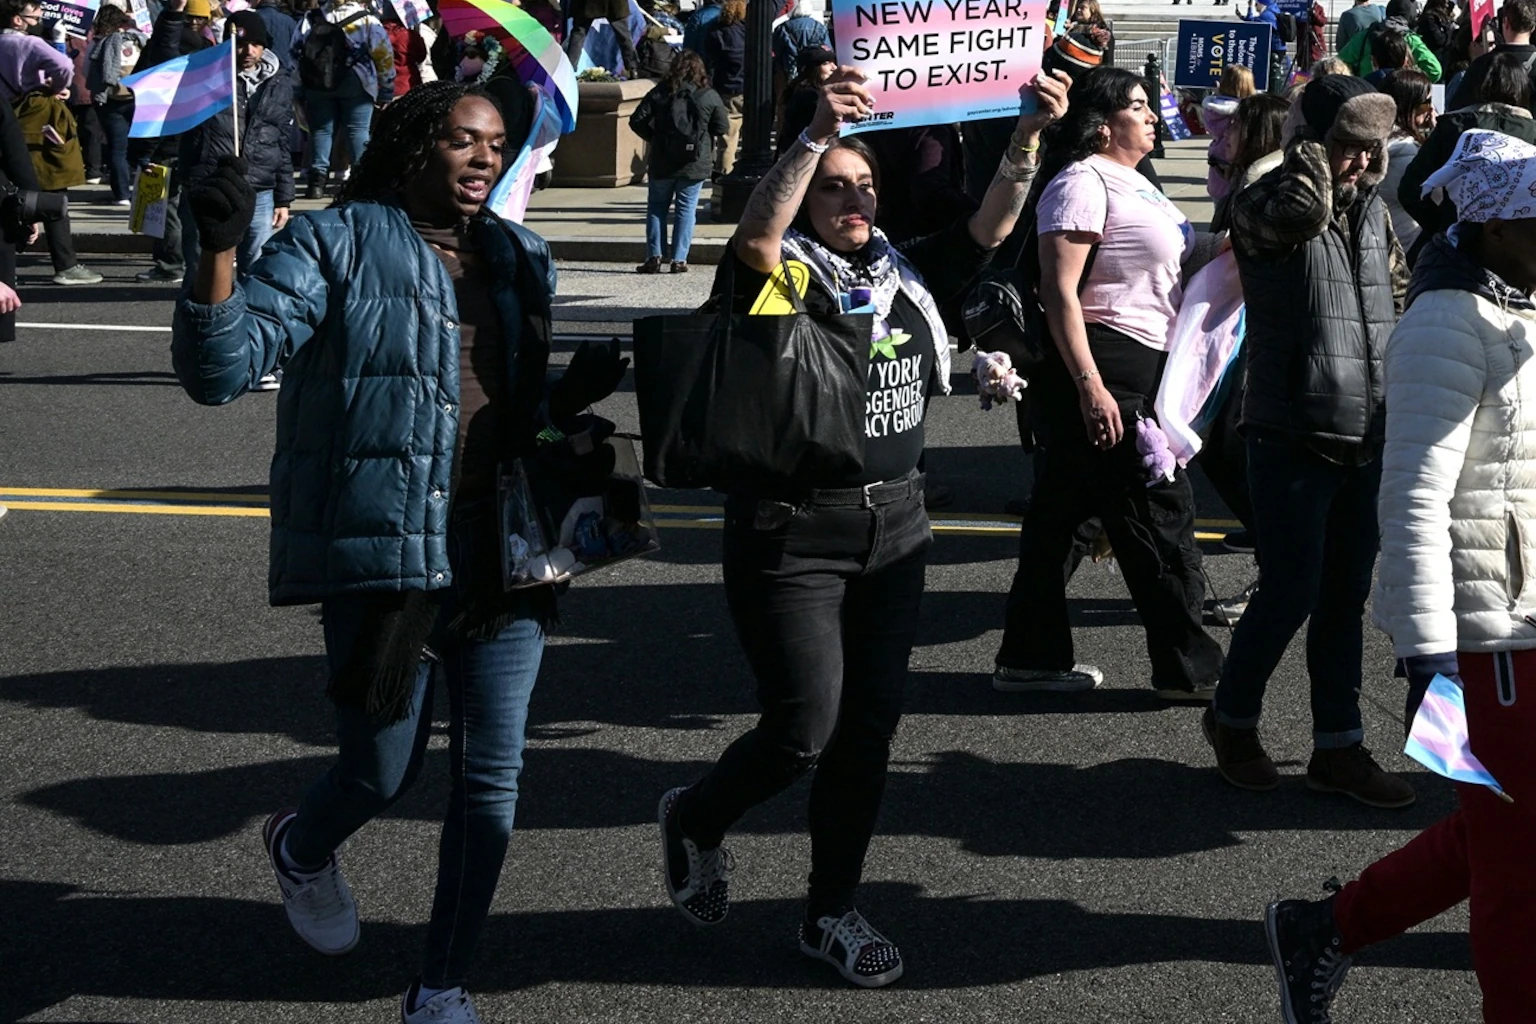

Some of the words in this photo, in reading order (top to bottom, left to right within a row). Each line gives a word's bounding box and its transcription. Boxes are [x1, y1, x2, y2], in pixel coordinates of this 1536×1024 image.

[61, 6, 84, 17] loves
[63, 14, 81, 24] kids
[855, 0, 933, 27] NEW
[852, 33, 940, 61] SAME
[950, 26, 1032, 54] FIGHT
[1229, 29, 1237, 39] to
[1249, 36, 1257, 52] The
[1189, 37, 1197, 71] LIBERTY
[1209, 33, 1225, 76] VOTE
[1227, 39, 1236, 63] those
[1246, 51, 1256, 72] futur
[878, 68, 917, 92] TO
[927, 59, 1009, 87] EXIST.
[877, 354, 922, 389] YORK
[893, 397, 924, 434] GROU
